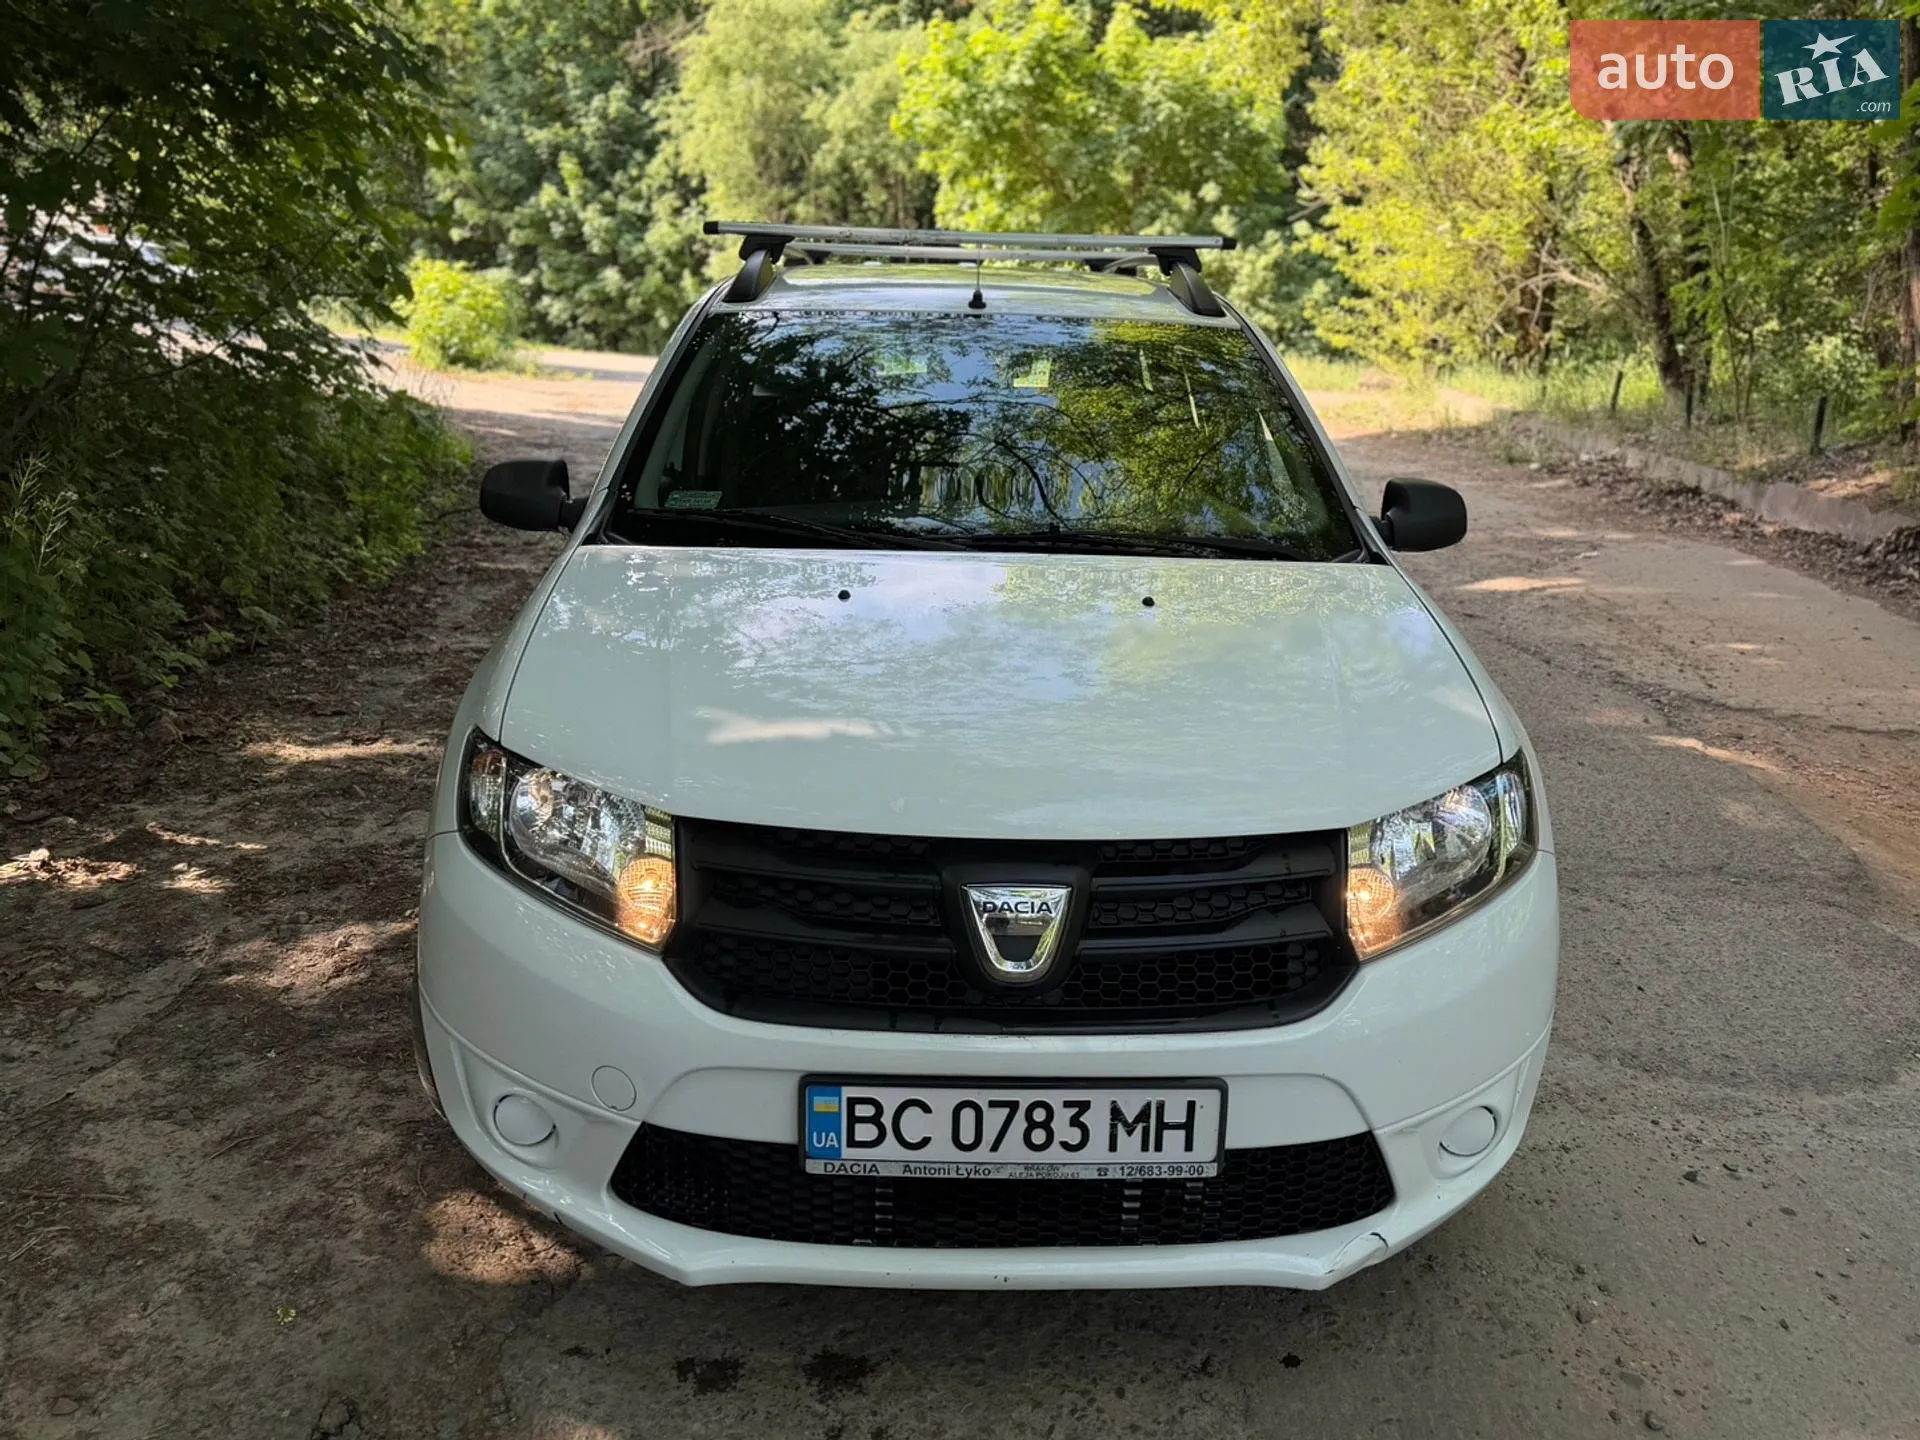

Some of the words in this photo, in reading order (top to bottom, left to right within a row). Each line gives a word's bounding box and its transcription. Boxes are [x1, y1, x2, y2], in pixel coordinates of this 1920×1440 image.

[982, 901, 1053, 914] DACIA
[845, 1096, 933, 1151] BC
[951, 1099, 1092, 1153] 0783
[1108, 1099, 1197, 1153] MH
[813, 1131, 839, 1149] UA
[823, 1162, 880, 1175] DACIA
[902, 1164, 951, 1176] Antoni
[955, 1165, 992, 1178] Łyko
[1119, 1165, 1204, 1177] 12/683-99-00
